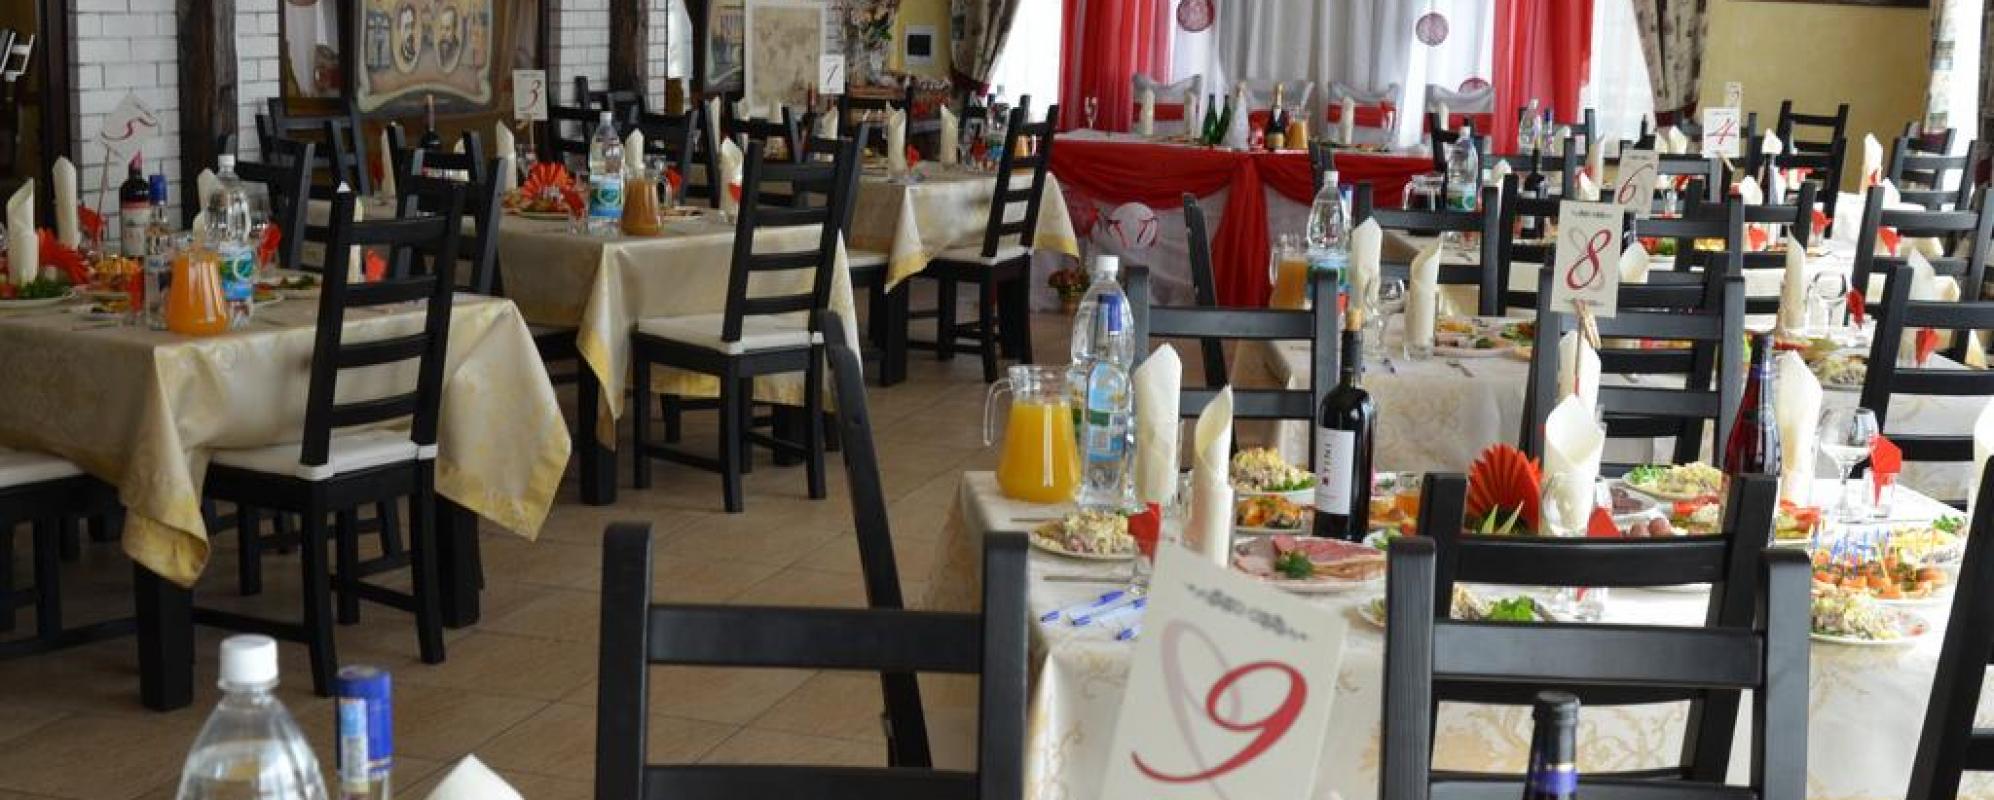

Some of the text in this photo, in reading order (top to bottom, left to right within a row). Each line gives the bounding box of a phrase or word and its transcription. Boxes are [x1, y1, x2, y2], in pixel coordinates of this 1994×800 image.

[518, 79, 542, 112] 3
[1706, 117, 1738, 145] 4
[1617, 162, 1655, 205] 6
[1566, 229, 1613, 290] 8
[1131, 661, 1308, 784] 9
